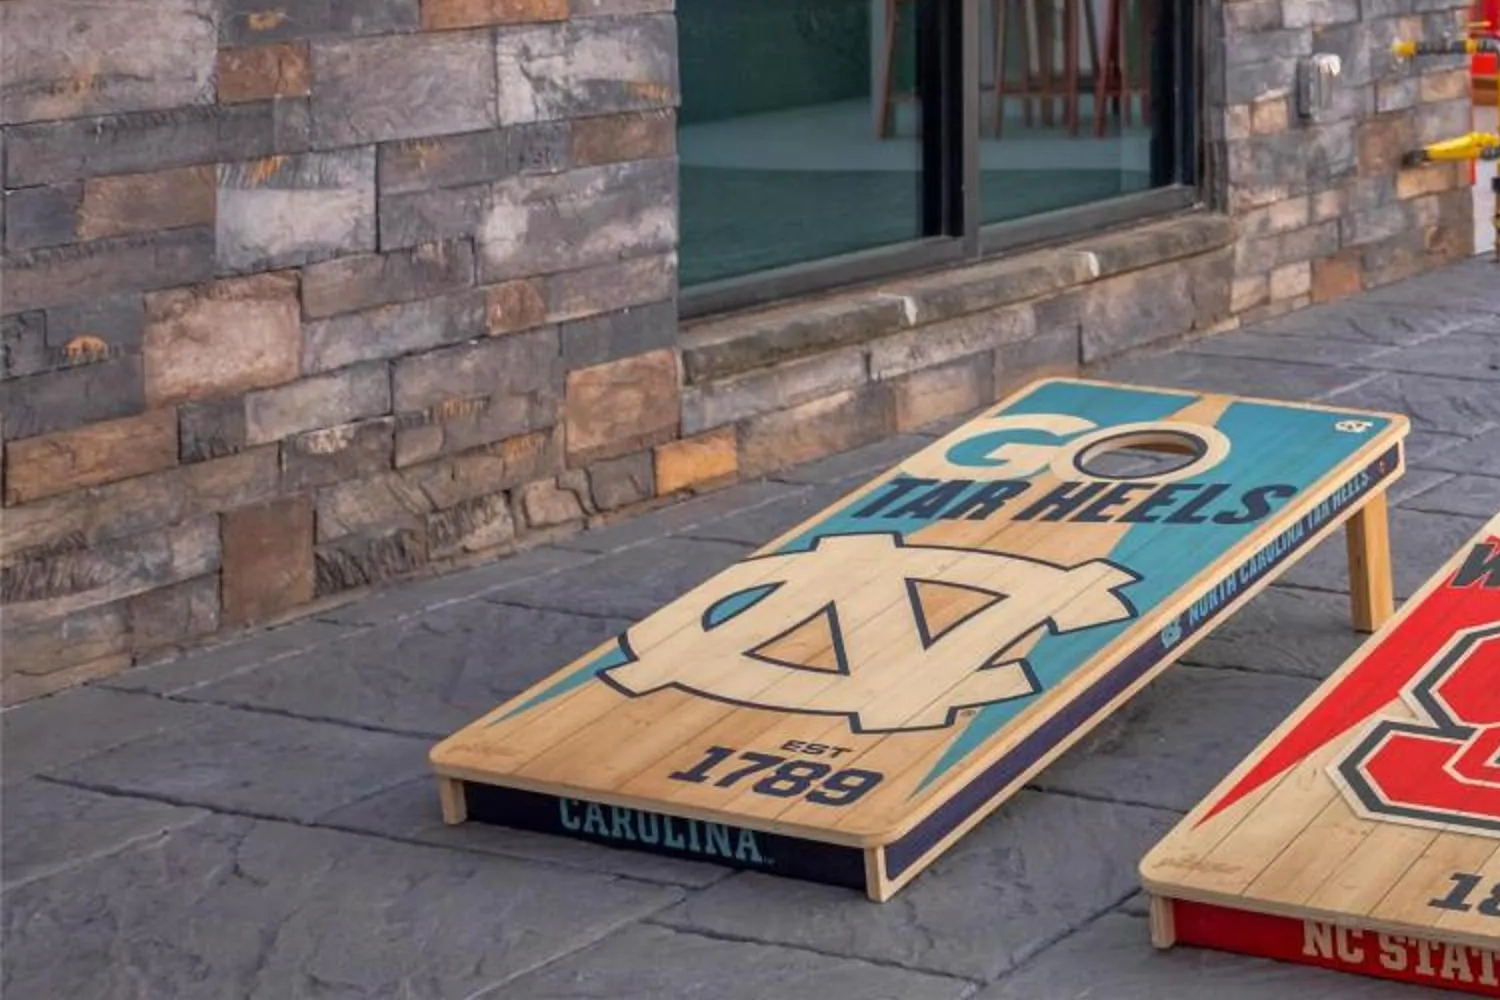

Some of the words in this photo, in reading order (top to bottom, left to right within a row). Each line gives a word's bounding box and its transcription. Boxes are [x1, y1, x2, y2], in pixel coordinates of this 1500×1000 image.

[850, 478, 1026, 519] TAR
[1010, 481, 1300, 525] HEELS
[1188, 573, 1237, 624] NORTH
[1239, 522, 1304, 582] CAROLINA
[1307, 500, 1331, 530] TAR
[1332, 471, 1370, 506] HEELS
[780, 738, 854, 759] EST
[667, 745, 885, 807] 1789
[558, 797, 764, 863] CAROLINA
[1301, 919, 1366, 962] NC
